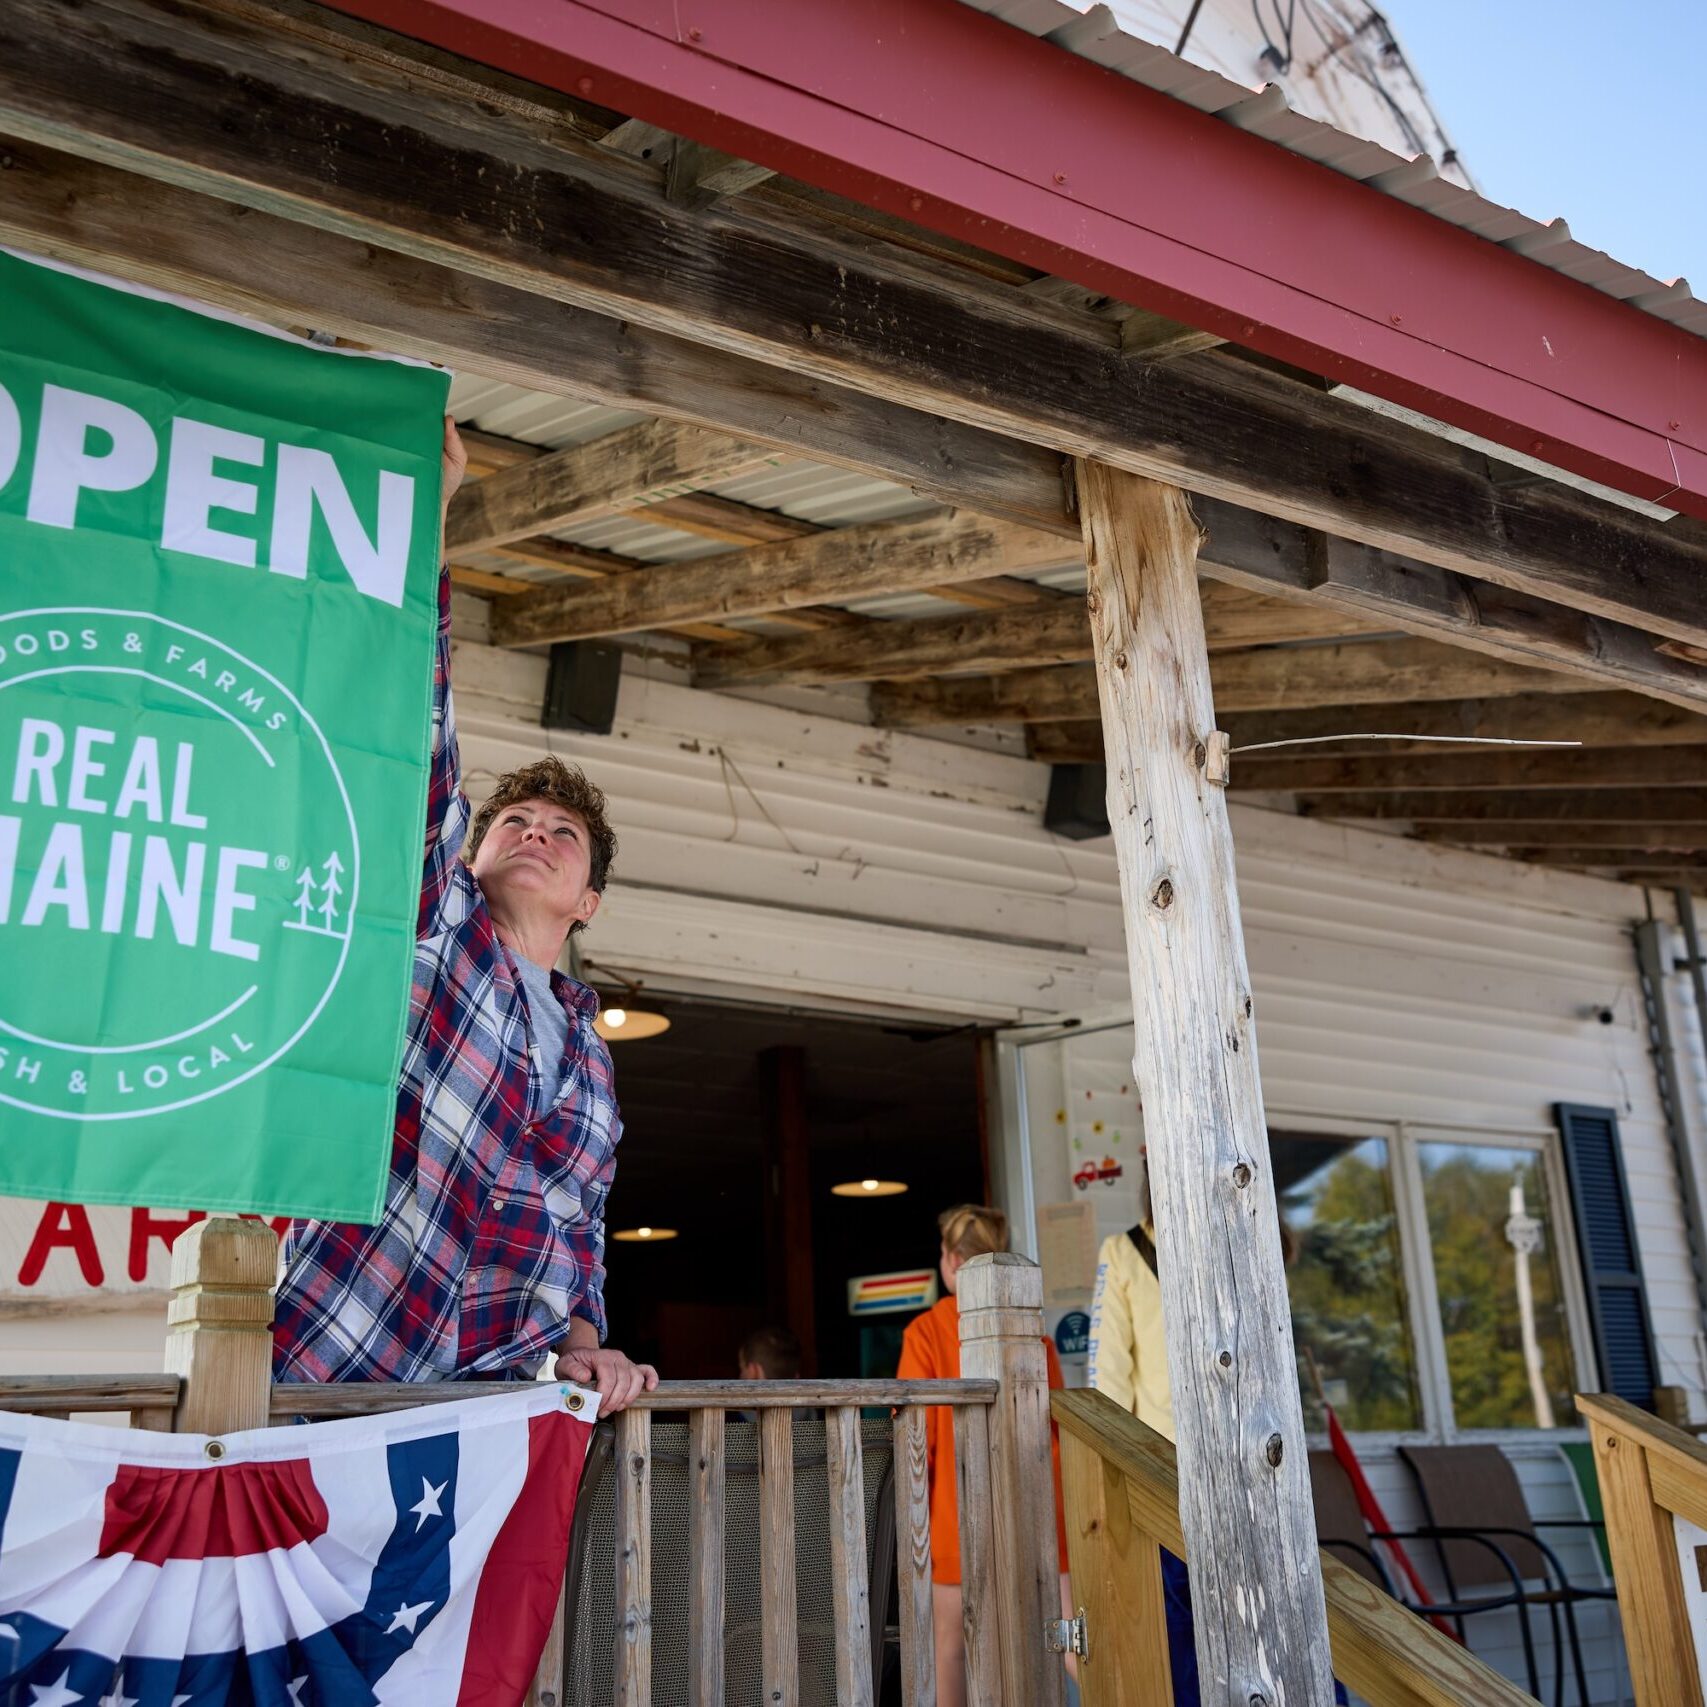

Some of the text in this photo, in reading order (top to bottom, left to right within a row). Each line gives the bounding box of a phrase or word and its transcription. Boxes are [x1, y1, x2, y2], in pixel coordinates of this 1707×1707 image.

[123, 633, 142, 653] &
[165, 645, 287, 730] FARMS
[12, 718, 207, 829] REAL
[67, 1070, 88, 1095] &
[118, 1033, 254, 1093] LOCAL
